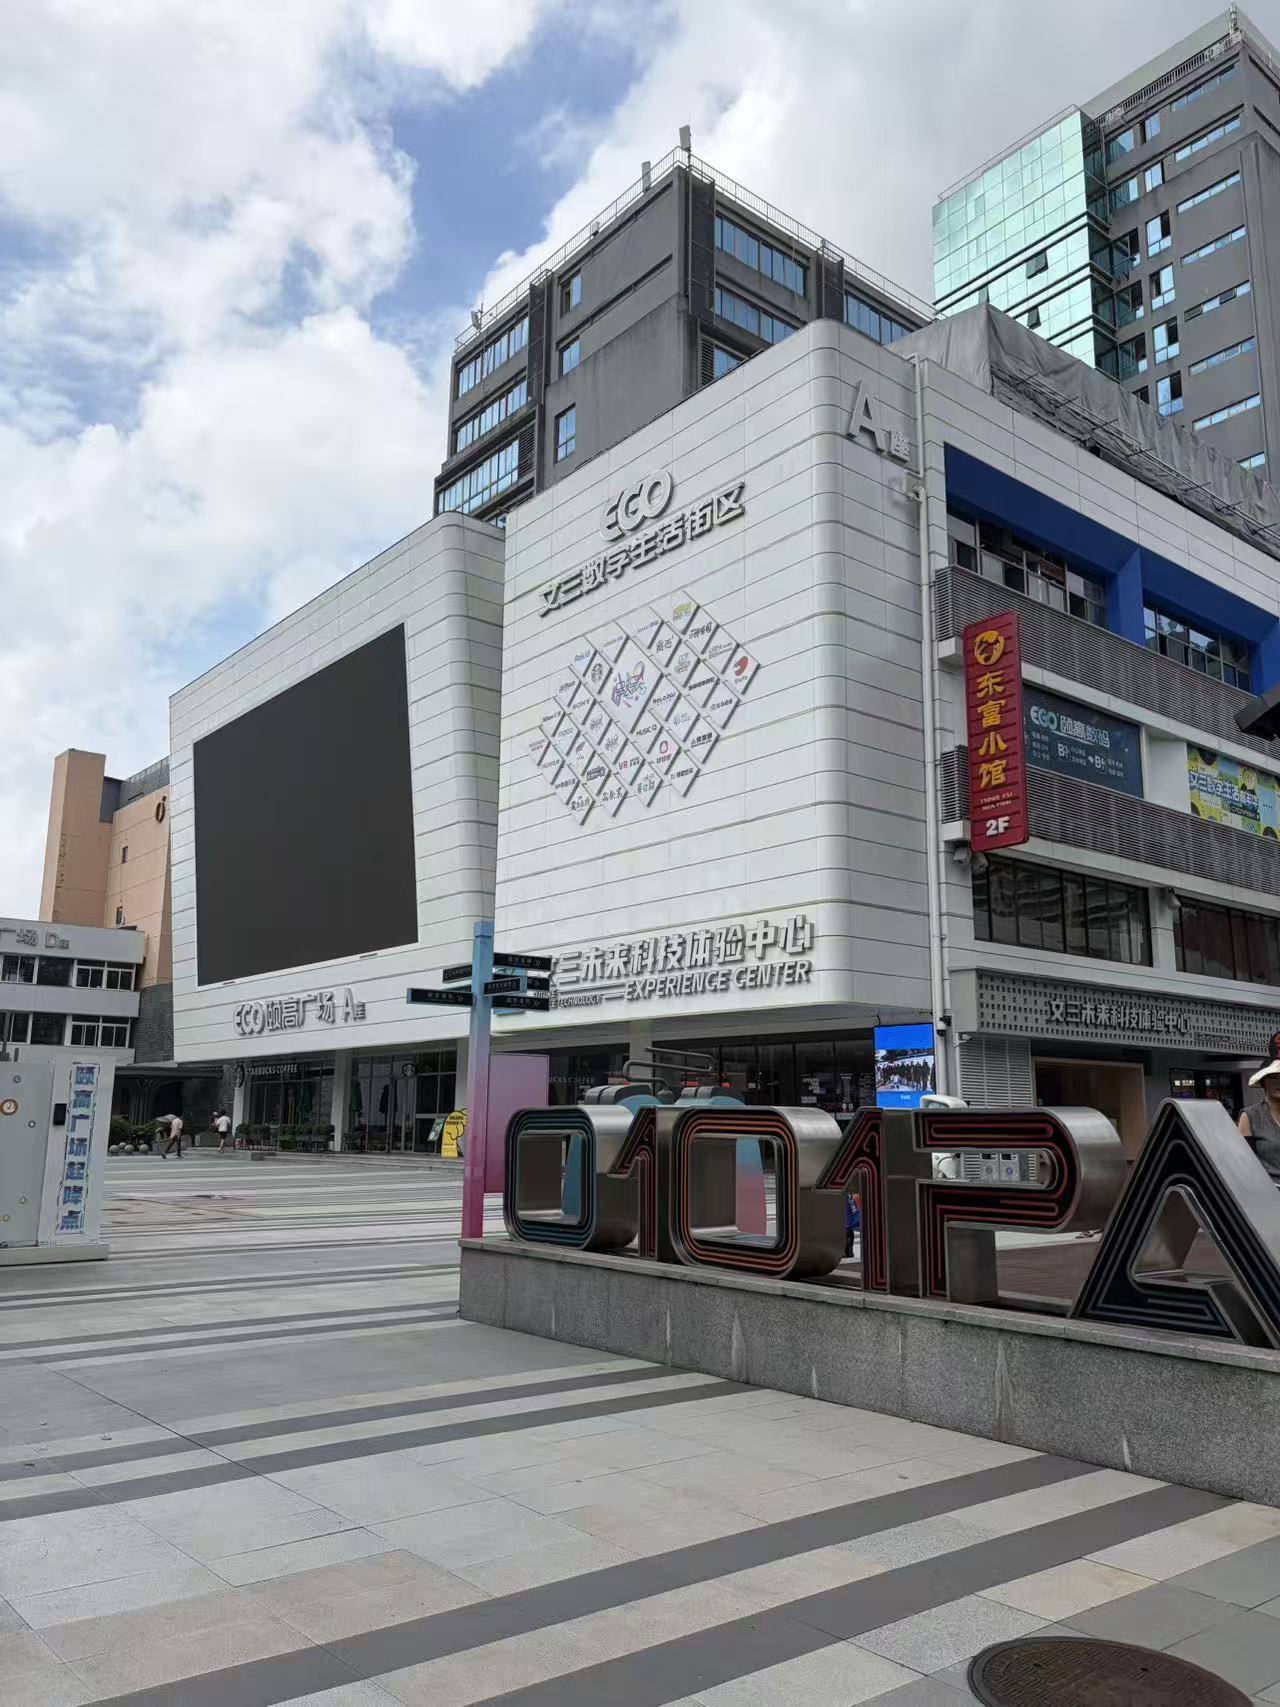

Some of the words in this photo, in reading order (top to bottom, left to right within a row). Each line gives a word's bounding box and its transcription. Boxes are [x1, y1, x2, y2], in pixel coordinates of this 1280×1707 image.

[539, 481, 746, 618] 文三数字生活街区
[572, 699, 591, 710] SONY
[976, 671, 1008, 789] 东富小馆
[985, 816, 1011, 837] 2F
[624, 970, 732, 1001] EXPERIENCE
[733, 959, 812, 987] CENTER
[266, 992, 336, 1031] 颐高广场
[557, 994, 602, 1009] TECHNOLOGY
[1049, 998, 1191, 1034] 文三未来科技体验中心
[275, 1063, 299, 1074] COFFEE
